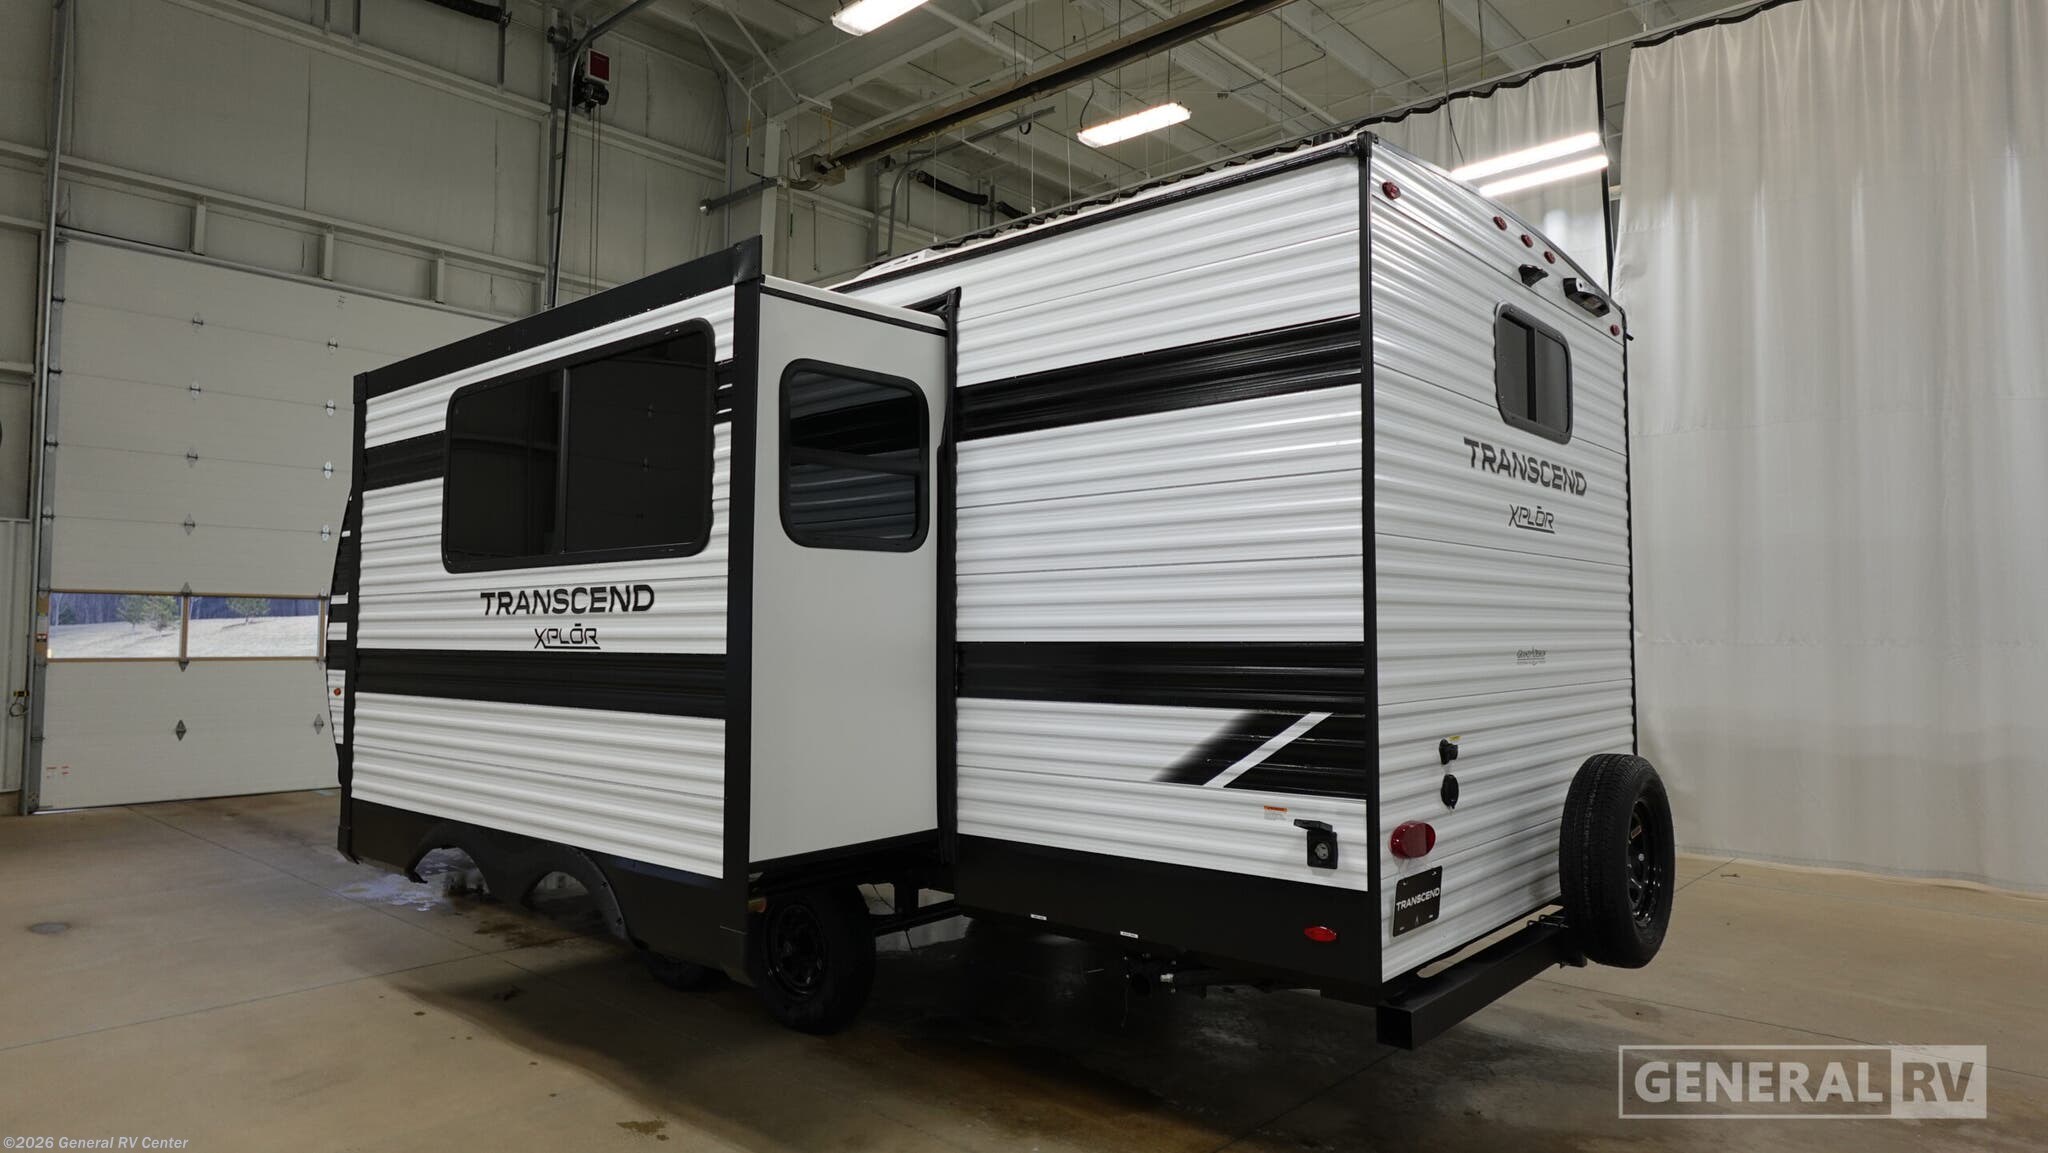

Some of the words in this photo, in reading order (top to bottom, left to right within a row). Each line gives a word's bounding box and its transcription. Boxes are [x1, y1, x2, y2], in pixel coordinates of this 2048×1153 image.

[1464, 436, 1587, 496] TRANSCEND
[480, 584, 655, 616] TRANSCEND
[1396, 887, 1441, 912] TRANSCEND
